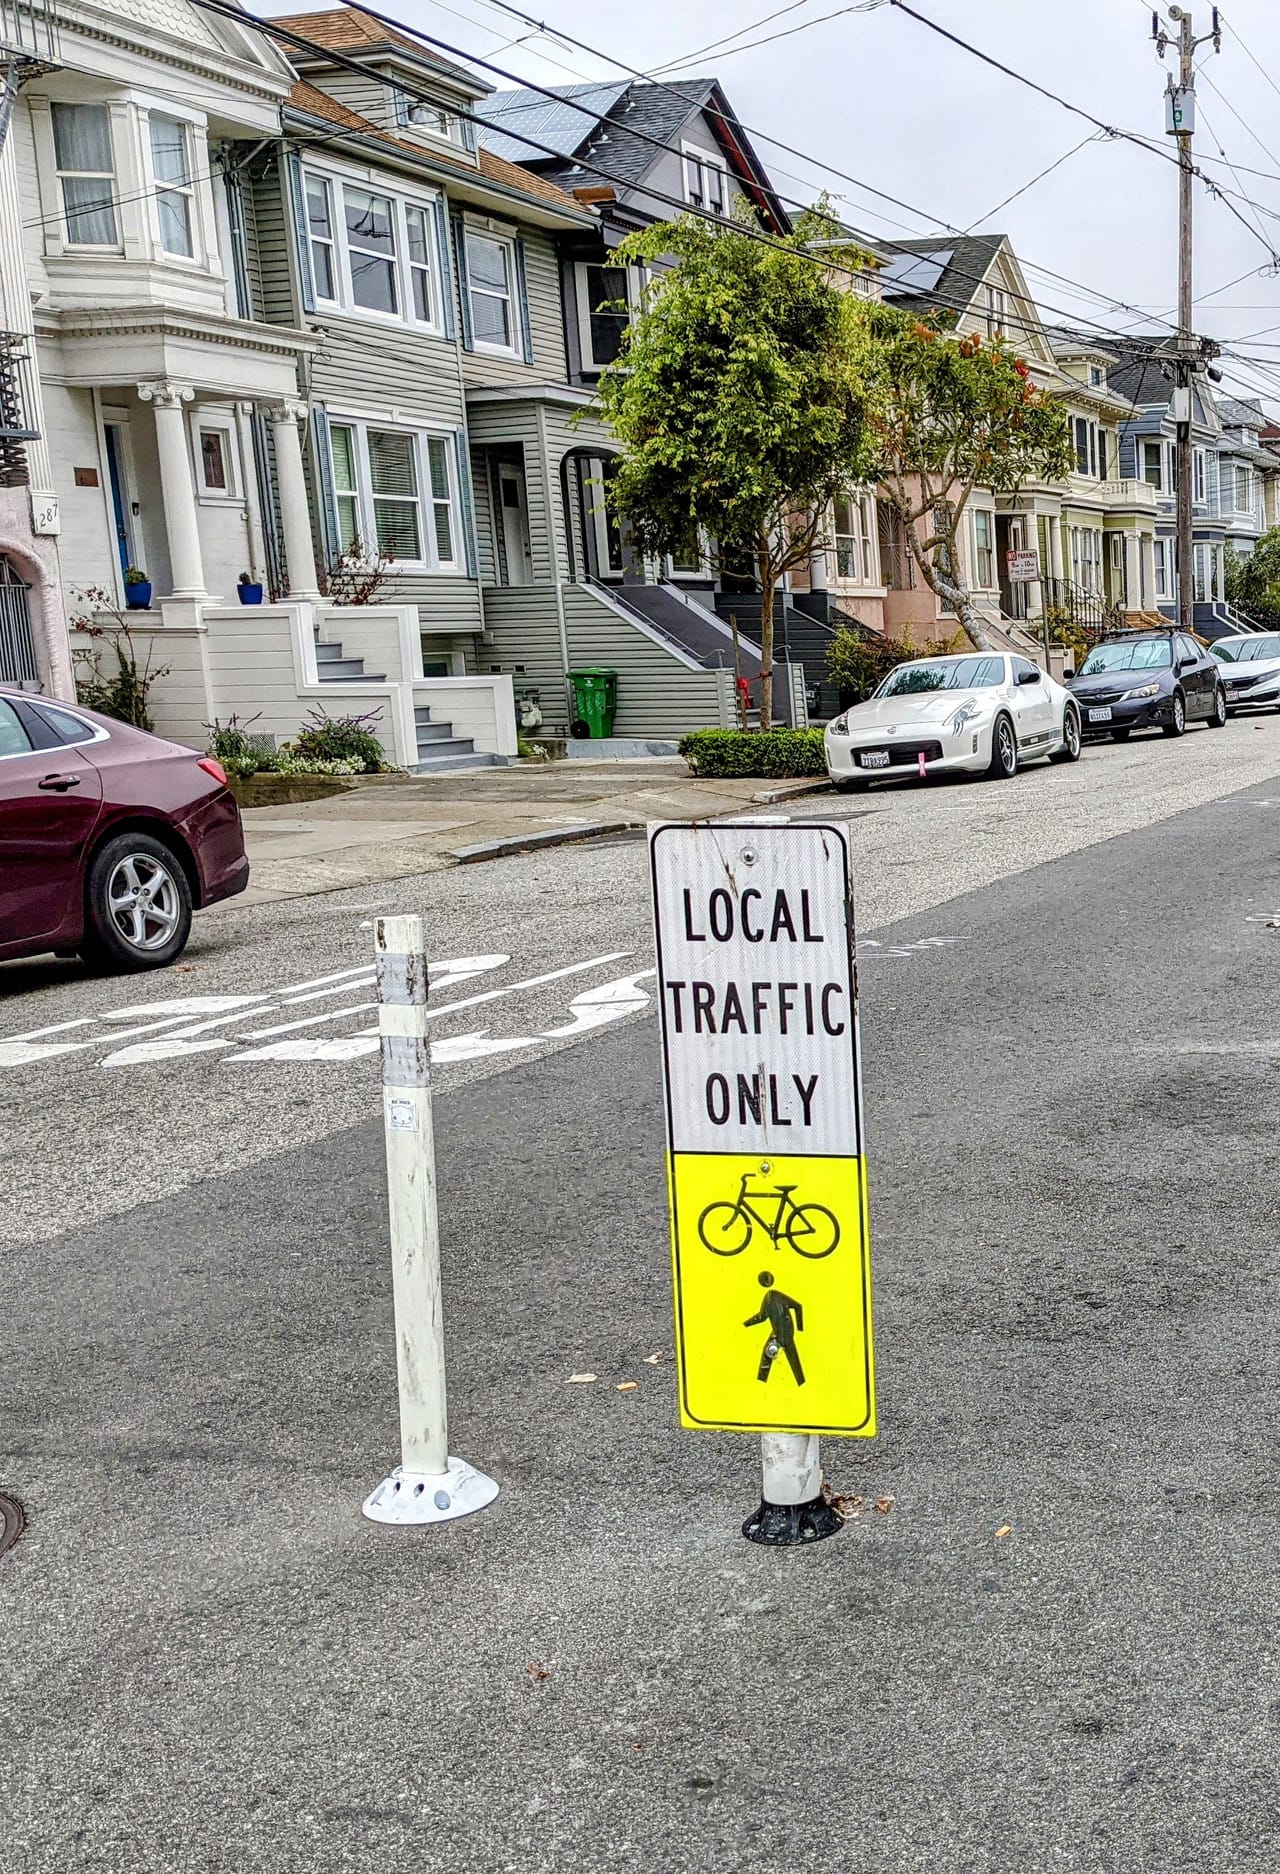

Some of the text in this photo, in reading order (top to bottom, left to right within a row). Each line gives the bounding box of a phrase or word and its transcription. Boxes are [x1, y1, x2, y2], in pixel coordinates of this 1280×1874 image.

[683, 888, 824, 943] LOCAL
[666, 981, 845, 1036] TRAFFIC
[706, 1072, 819, 1127] ONLY
